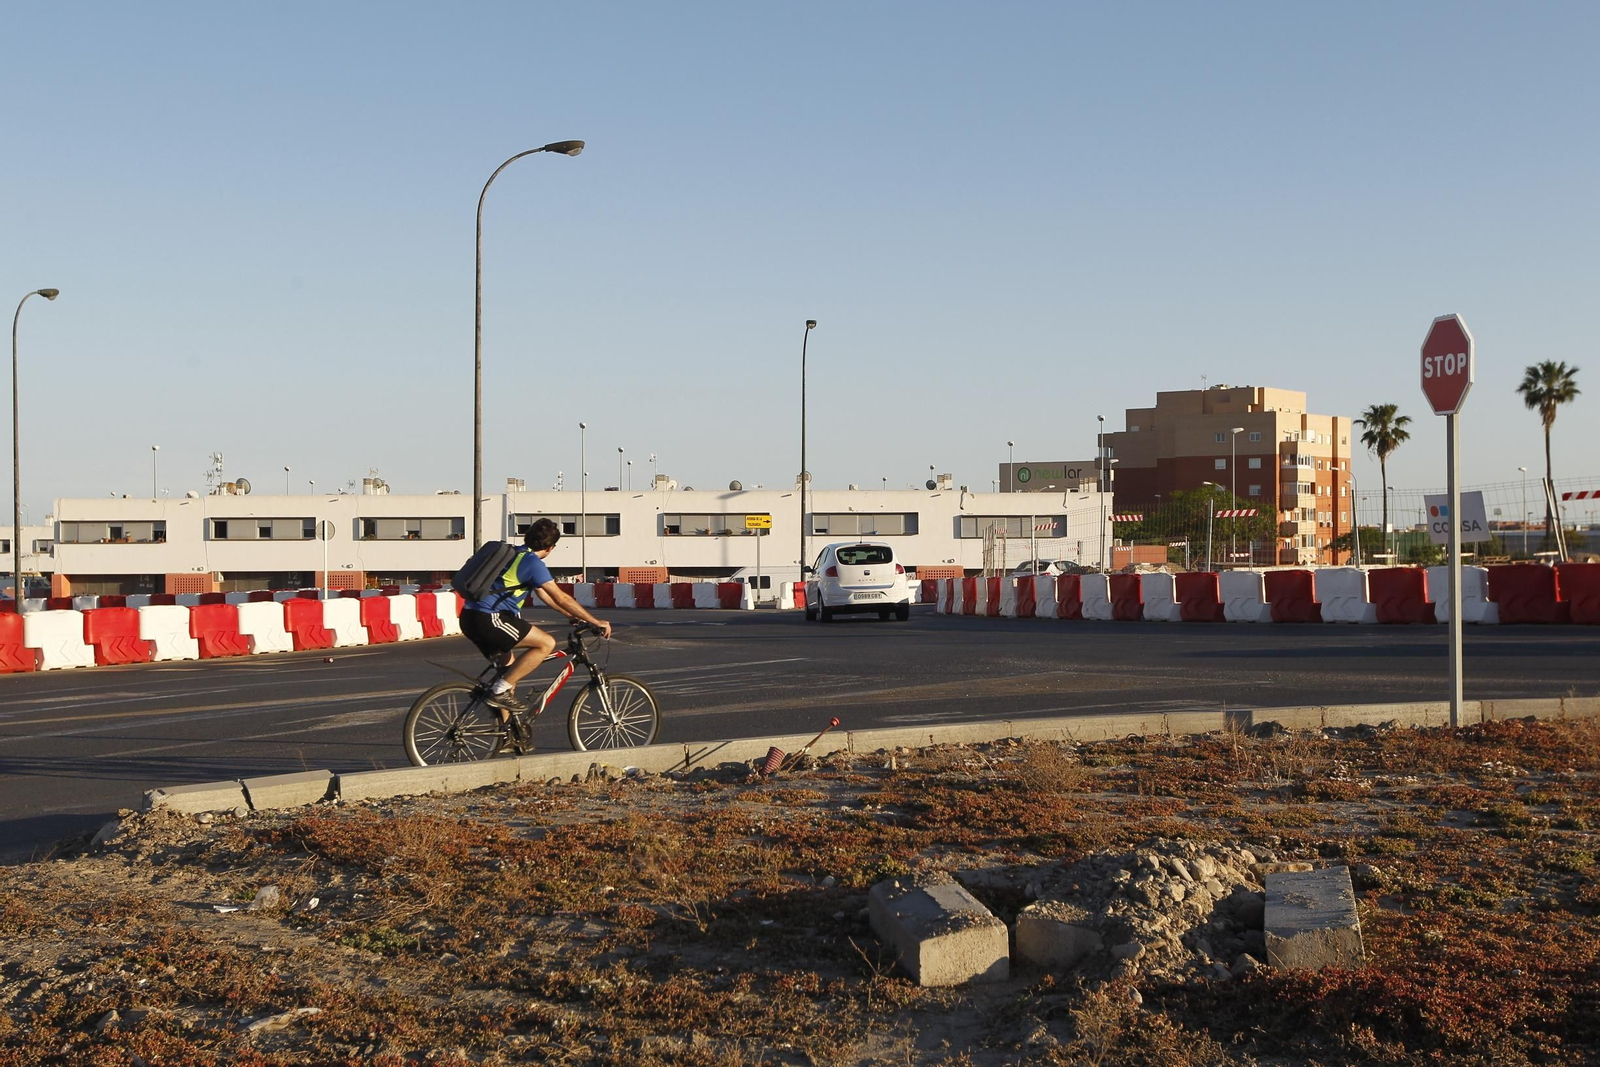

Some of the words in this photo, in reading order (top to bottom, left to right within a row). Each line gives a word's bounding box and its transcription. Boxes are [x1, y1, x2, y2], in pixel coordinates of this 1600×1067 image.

[1424, 352, 1467, 378] STOP
[1034, 465, 1082, 479] newlar
[1433, 519, 1482, 534] COSA
